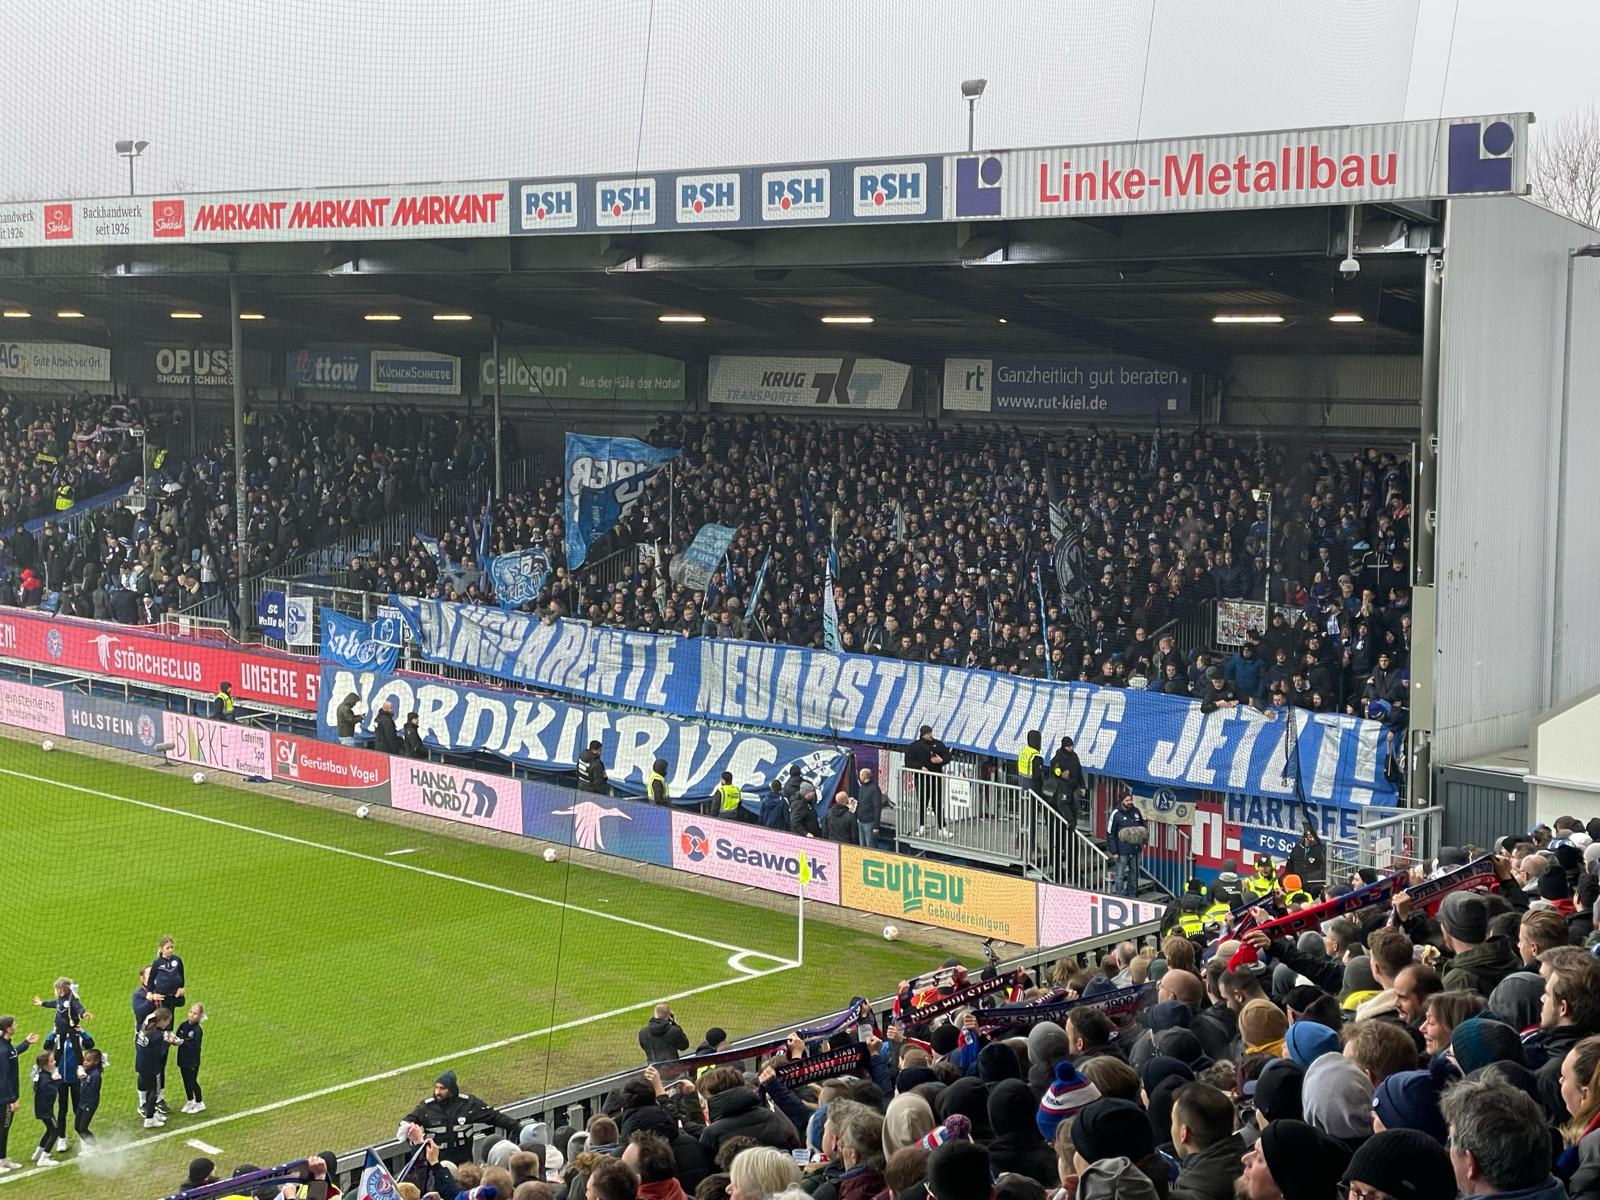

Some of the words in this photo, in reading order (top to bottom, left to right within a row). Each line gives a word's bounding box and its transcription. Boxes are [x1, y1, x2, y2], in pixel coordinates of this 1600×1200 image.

[860, 172, 920, 200] RSH
[1039, 145, 1397, 203] Linke-Metallbau
[526, 191, 572, 215] RSH
[601, 187, 650, 212] RSH
[682, 183, 734, 208] RSH
[768, 178, 824, 205] RSH
[83, 205, 142, 219] Backhandwerk
[193, 202, 287, 231] MARKANT
[288, 198, 391, 228] MARKANT
[390, 193, 504, 226] MARKANT
[7, 227, 24, 239] 1926
[95, 221, 110, 235] seit
[111, 223, 130, 234] 1926
[51, 355, 74, 367] Arbeit
[75, 358, 88, 367] vor
[156, 349, 230, 375] OPUS
[597, 375, 612, 388] der
[654, 376, 681, 389] Natur
[761, 371, 807, 388] KRUG
[965, 364, 984, 392] rt
[998, 365, 1083, 385] Ganzheitlich
[1089, 368, 1114, 389] gut
[997, 394, 1107, 411] www.rut-kiel.de
[114, 646, 202, 682] STÖRCHECLUB
[241, 663, 298, 699] UNSERE
[72, 709, 134, 737] HOLSTEIN
[695, 640, 1126, 770] NEUABSTIMMUNG
[1147, 700, 1383, 807] JETZT!
[176, 717, 229, 768] BIRKE
[253, 747, 265, 761] Spa
[300, 754, 348, 776] Gerüstbau
[349, 764, 379, 783] Vogel
[410, 767, 457, 792] HANSA
[422, 787, 462, 812] NORD
[1259, 834, 1276, 850] FC
[927, 902, 1011, 935] Gebäudereinigung
